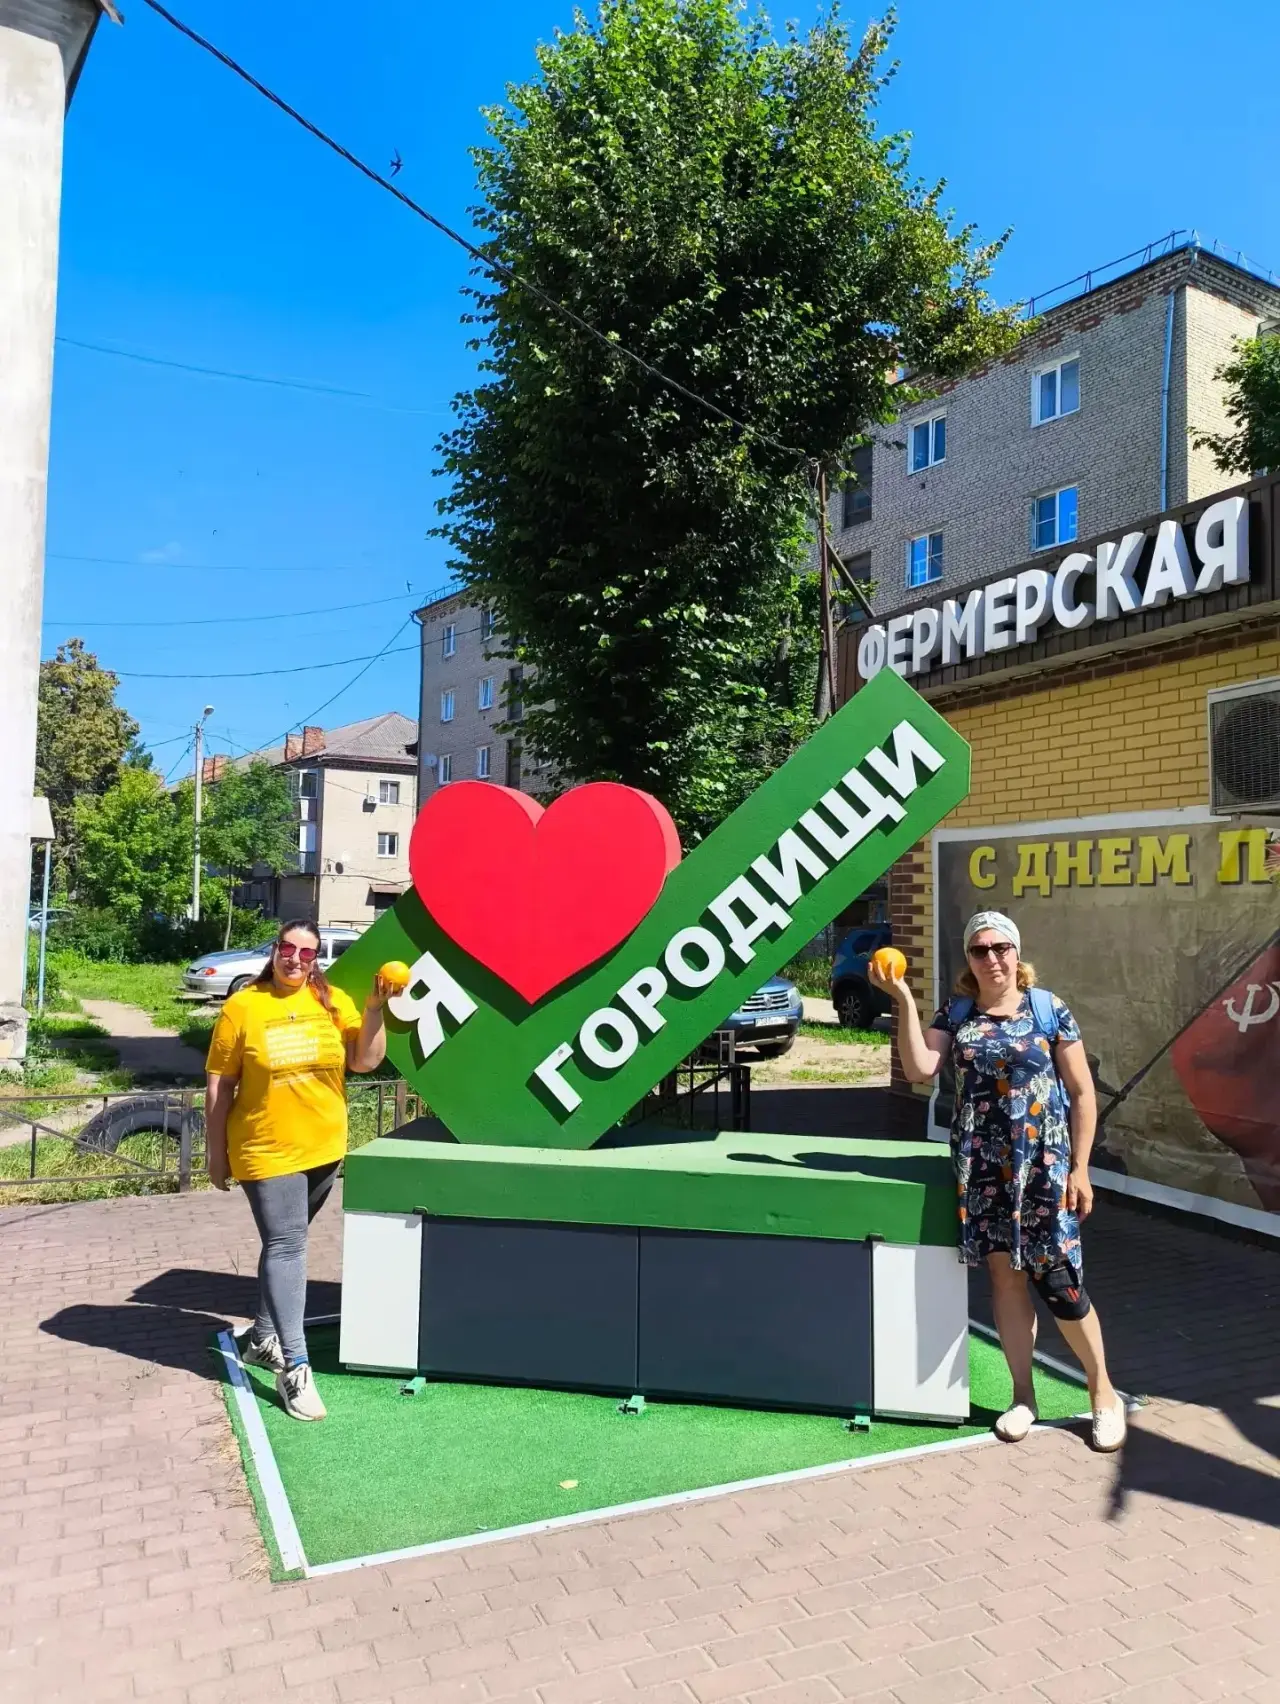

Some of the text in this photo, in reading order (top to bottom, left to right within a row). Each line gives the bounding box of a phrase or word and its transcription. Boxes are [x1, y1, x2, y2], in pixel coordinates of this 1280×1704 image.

[857, 496, 1250, 682] ФЕРМЕРСКАЯ
[533, 719, 946, 1113] ГОРОДИЩИ
[969, 846, 995, 888] С
[1013, 833, 1191, 897] ДНЕМ
[388, 950, 478, 1059] Я
